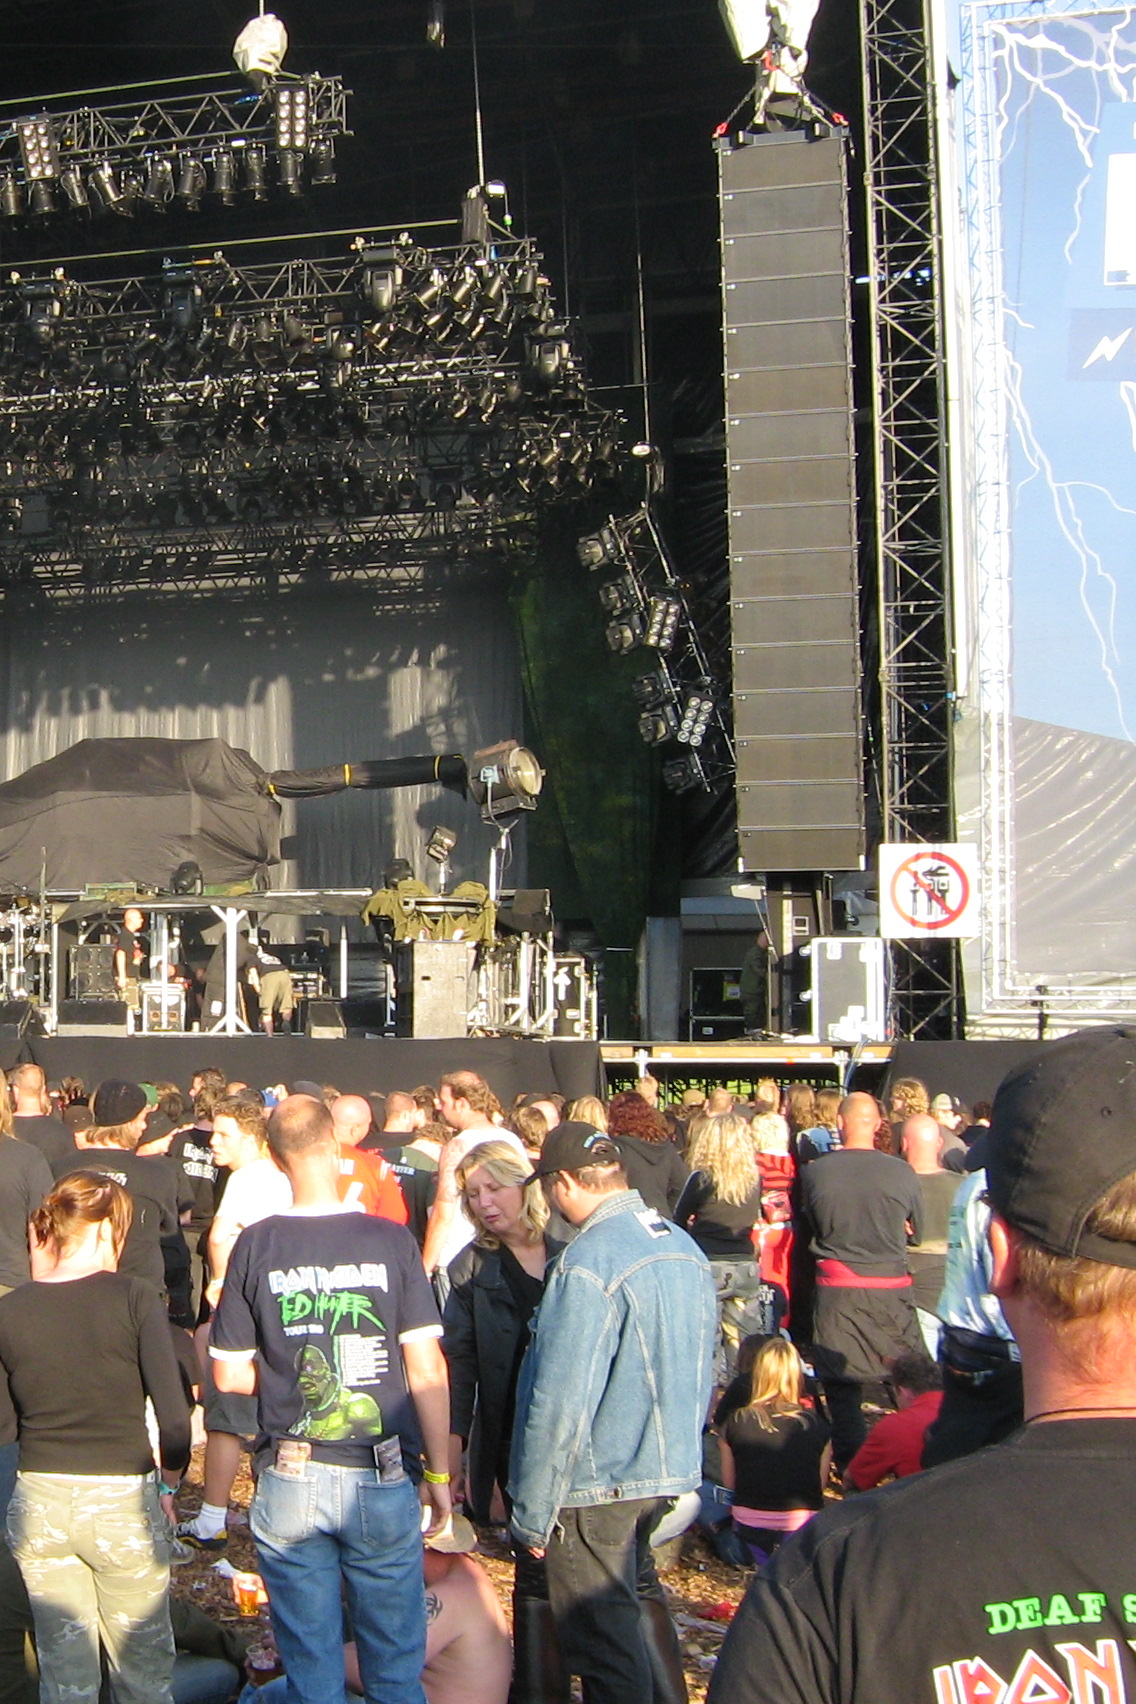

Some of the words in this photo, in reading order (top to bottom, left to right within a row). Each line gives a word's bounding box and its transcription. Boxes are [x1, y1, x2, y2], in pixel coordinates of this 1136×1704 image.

[267, 1266, 319, 1298] IRON
[314, 1263, 388, 1295] MAIDEN
[276, 1291, 313, 1327] ED
[313, 1290, 387, 1336] HUNTER
[984, 1592, 1108, 1635] DEAF
